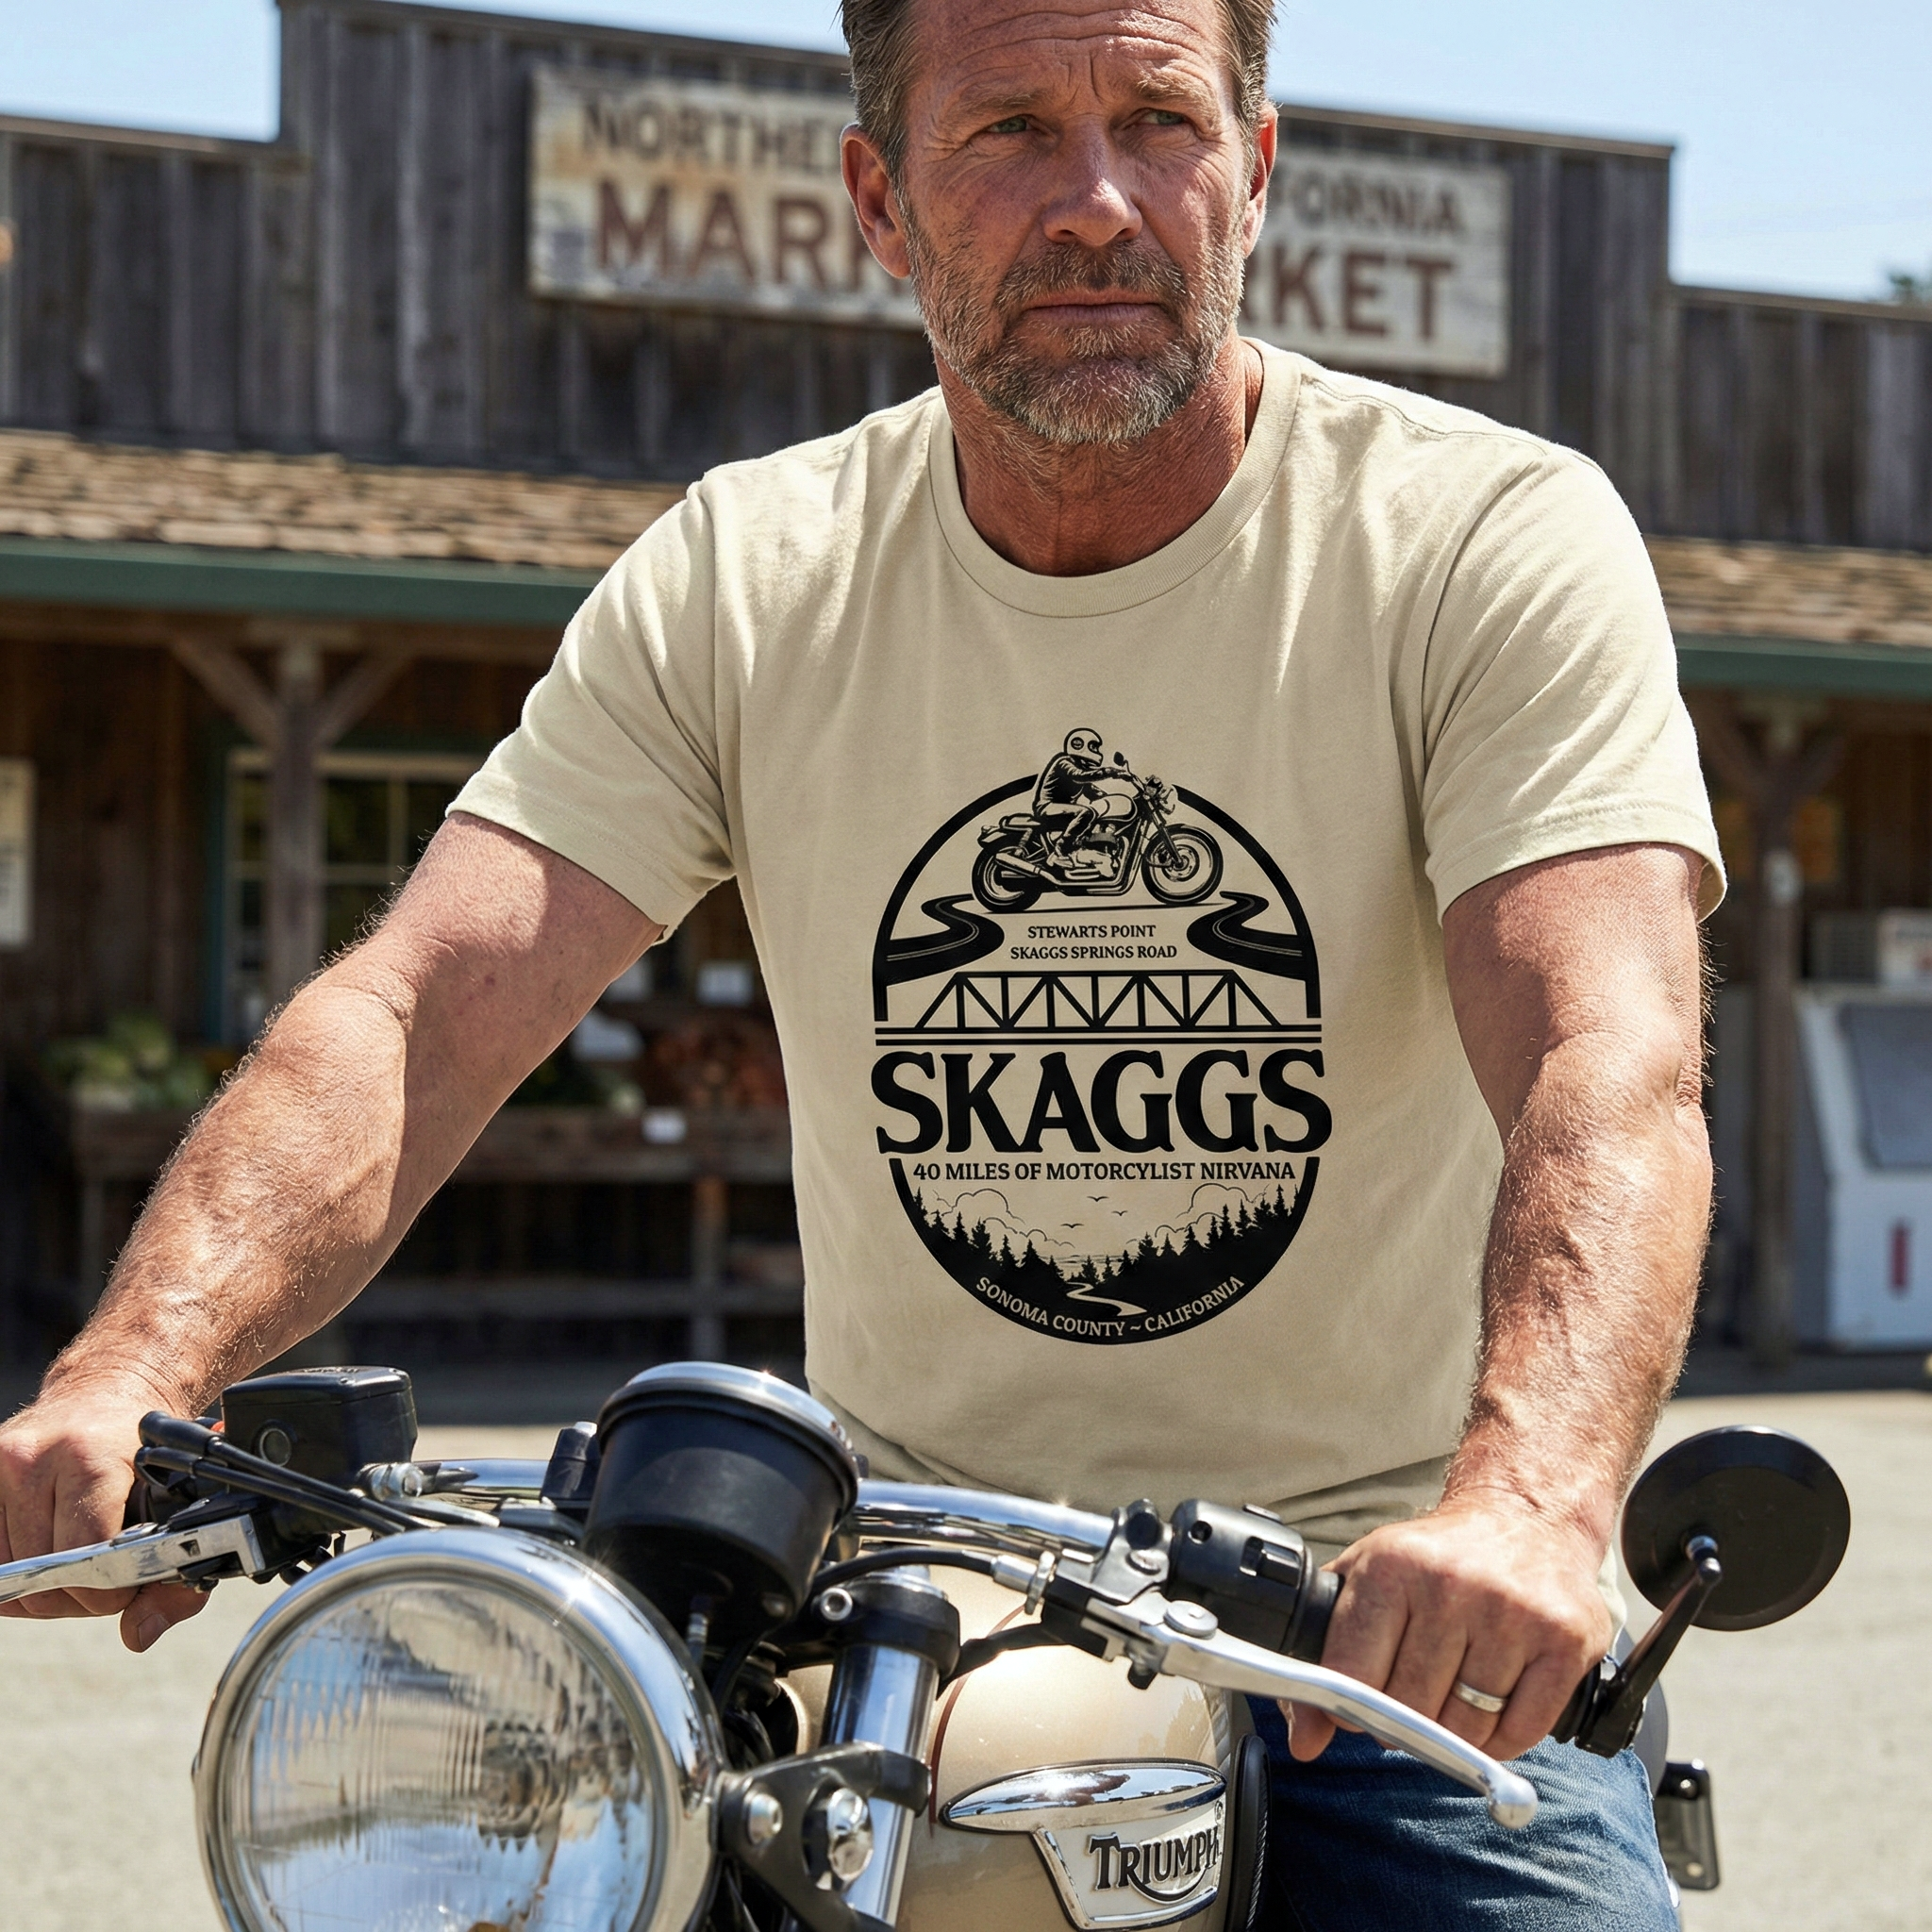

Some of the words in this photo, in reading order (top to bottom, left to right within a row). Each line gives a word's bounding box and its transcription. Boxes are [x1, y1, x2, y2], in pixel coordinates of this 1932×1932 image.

[1027, 924, 1108, 939] STEWARTS
[1110, 924, 1157, 938] POINT
[1010, 946, 1068, 959] SKAGGS
[1071, 945, 1134, 958] SPRINGS
[1137, 945, 1177, 958] ROAD
[871, 1049, 1333, 1155] SKAGGS
[912, 1163, 941, 1181] 40
[945, 1163, 1009, 1180] MILES
[1014, 1163, 1041, 1180] OF
[1046, 1162, 1195, 1180] MOTORCYLIST
[1201, 1161, 1295, 1179] NIRVANA
[976, 1276, 1049, 1326] SONOMA
[1053, 1314, 1125, 1336] COUNTY
[1144, 1275, 1245, 1332] CALIFORNIA
[1089, 1825, 1220, 1900] TRIUMPH
